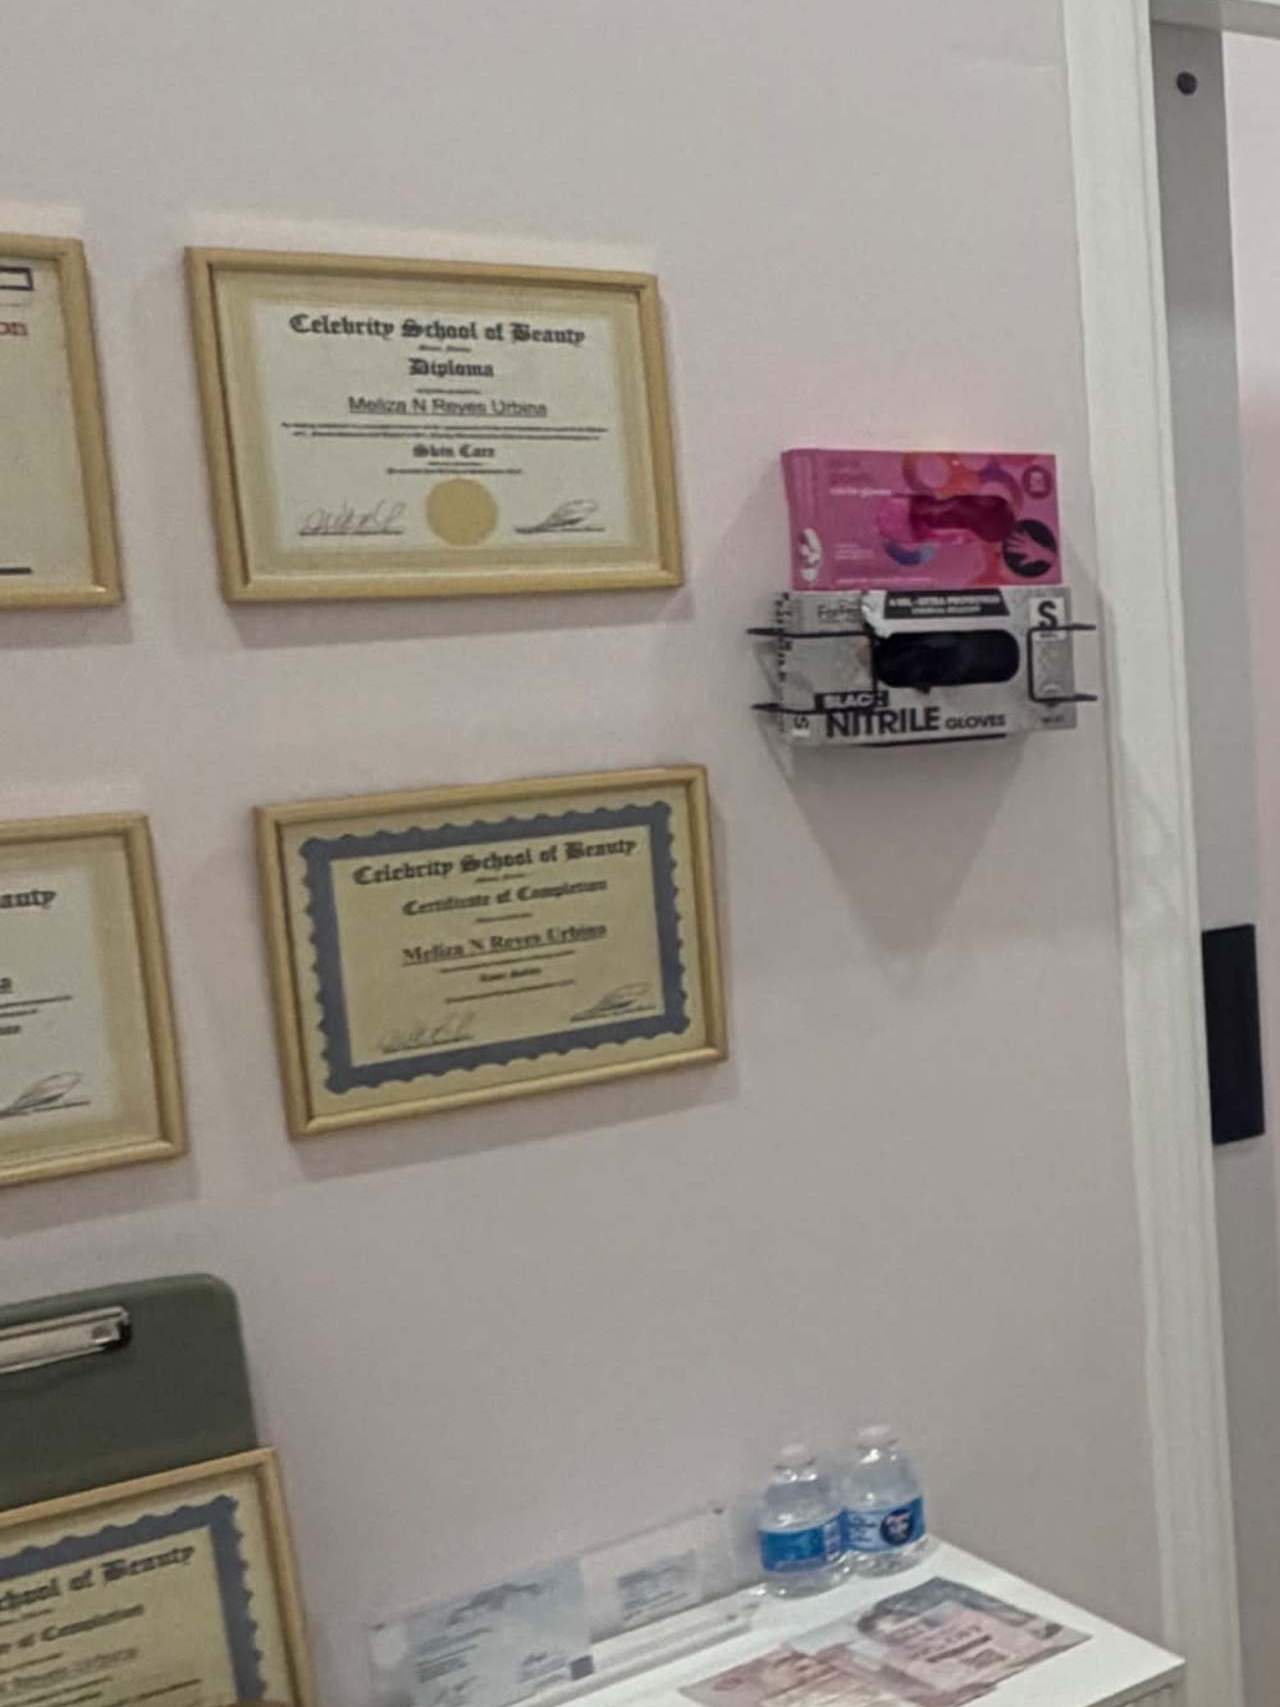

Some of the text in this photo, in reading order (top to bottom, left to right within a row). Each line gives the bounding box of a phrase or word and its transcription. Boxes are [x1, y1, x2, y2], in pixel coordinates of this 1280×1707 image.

[289, 313, 586, 346] Celebrity School of Beauty
[408, 357, 495, 379] Diploma
[1036, 600, 1059, 628] S
[826, 706, 941, 738] NITRILE
[945, 713, 1006, 730] GLOVES
[352, 859, 454, 885] Celebrity
[459, 848, 533, 873] School
[539, 844, 557, 863] of
[564, 839, 638, 861] Beauty
